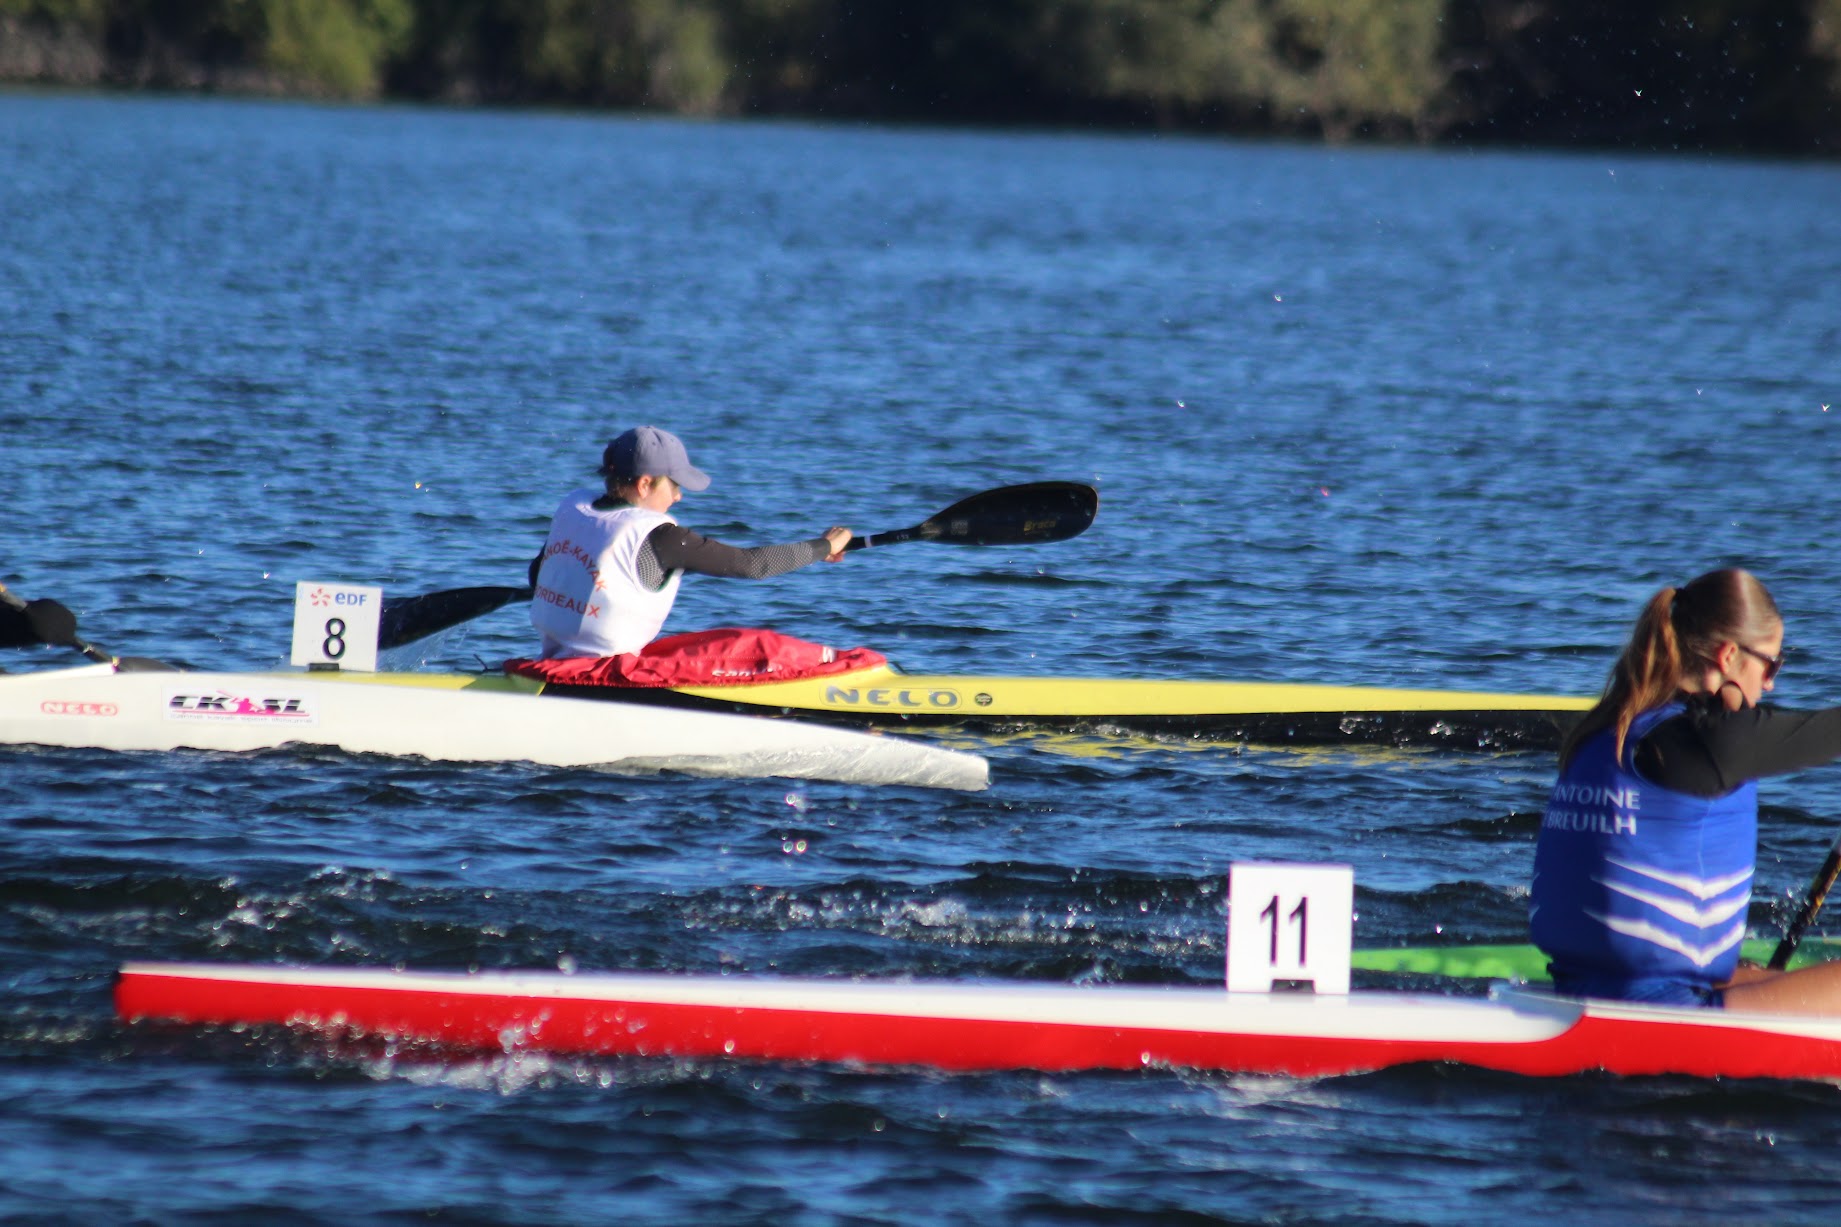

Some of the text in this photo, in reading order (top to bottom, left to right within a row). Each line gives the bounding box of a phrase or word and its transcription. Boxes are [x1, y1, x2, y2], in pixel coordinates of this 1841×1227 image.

[322, 617, 346, 661] 8
[42, 702, 118, 716] NELO
[825, 685, 959, 706] NELO
[1260, 894, 1308, 967] 11
